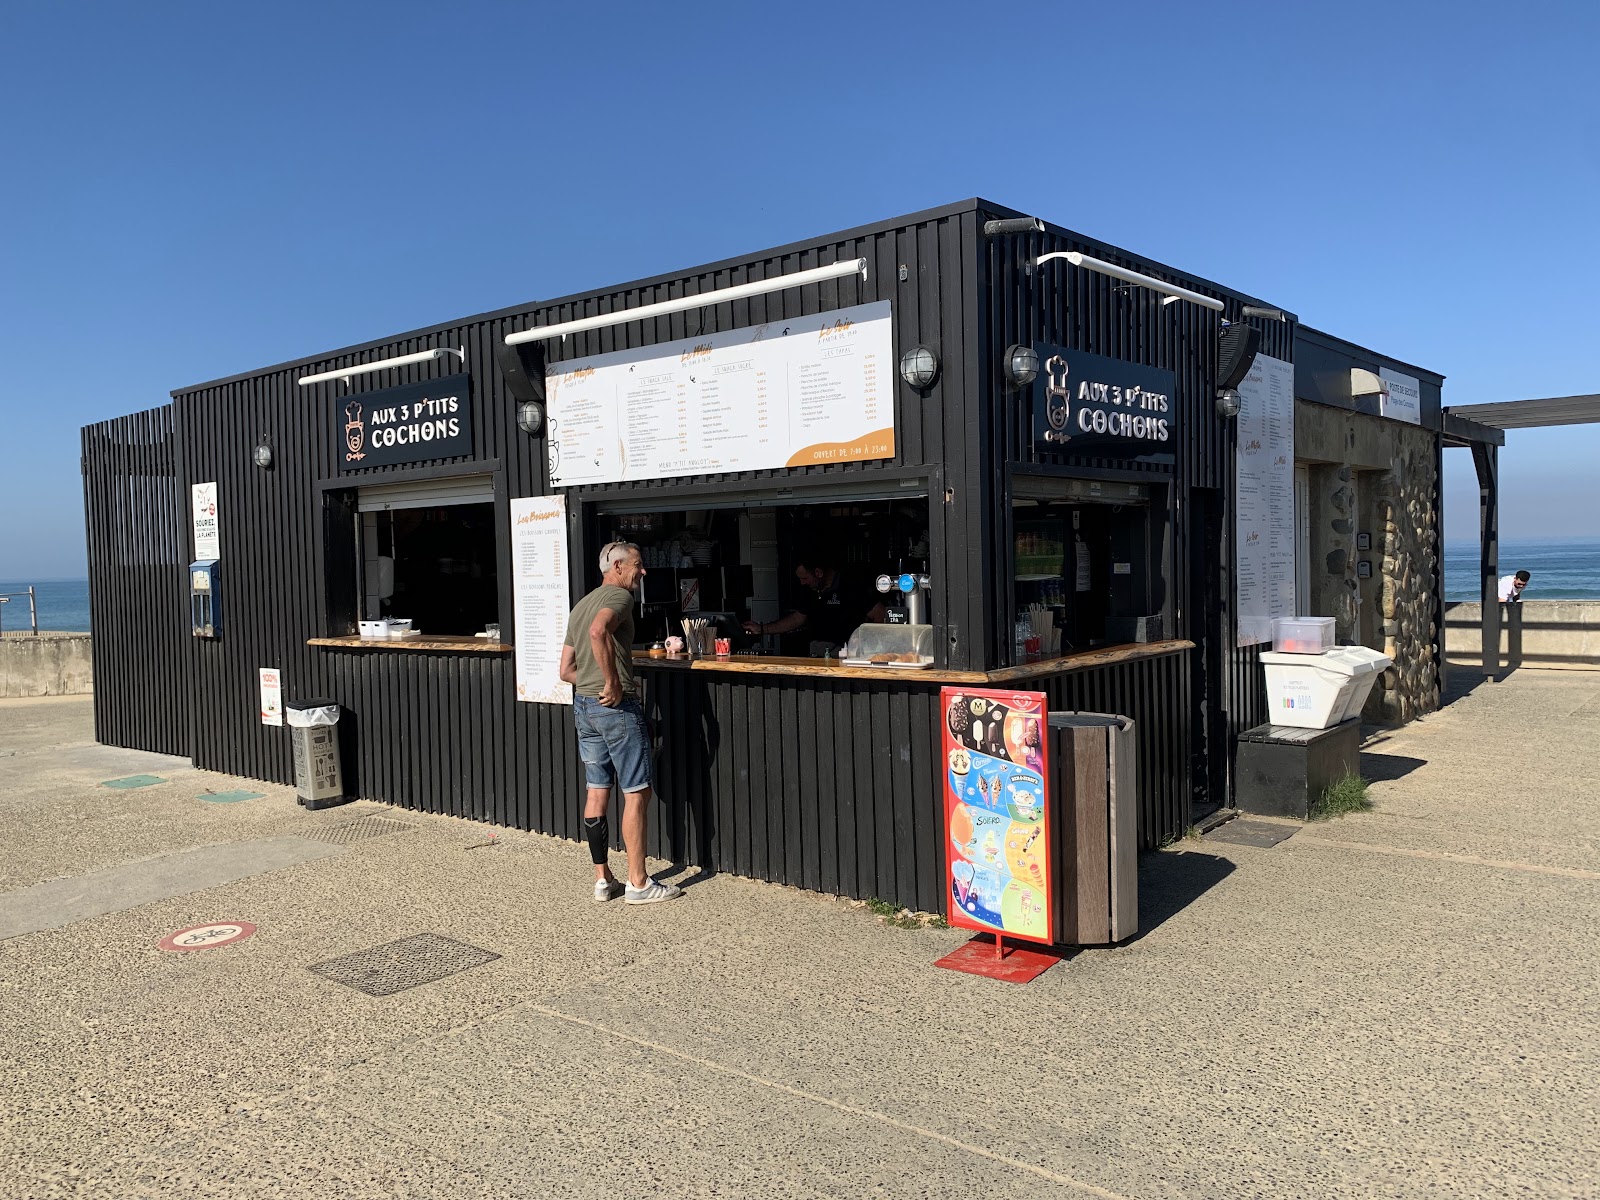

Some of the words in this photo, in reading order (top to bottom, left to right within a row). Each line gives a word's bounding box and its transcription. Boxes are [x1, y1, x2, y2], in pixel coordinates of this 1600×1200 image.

[371, 407, 397, 426] AUX
[401, 404, 410, 421] 3
[414, 397, 459, 419] P'TITS
[1078, 381, 1109, 404] AUX
[1112, 385, 1123, 406] 3
[1125, 385, 1169, 413] P'TITS
[371, 418, 461, 449] COCHONS
[1078, 407, 1169, 441] COCHONS
[813, 450, 836, 460] OUVERT
[839, 448, 848, 458] DE
[850, 447, 862, 456] 7:00
[864, 444, 869, 454] À
[871, 445, 888, 454] 23:00
[262, 673, 278, 684] 100%
[313, 742, 329, 750] HOT
